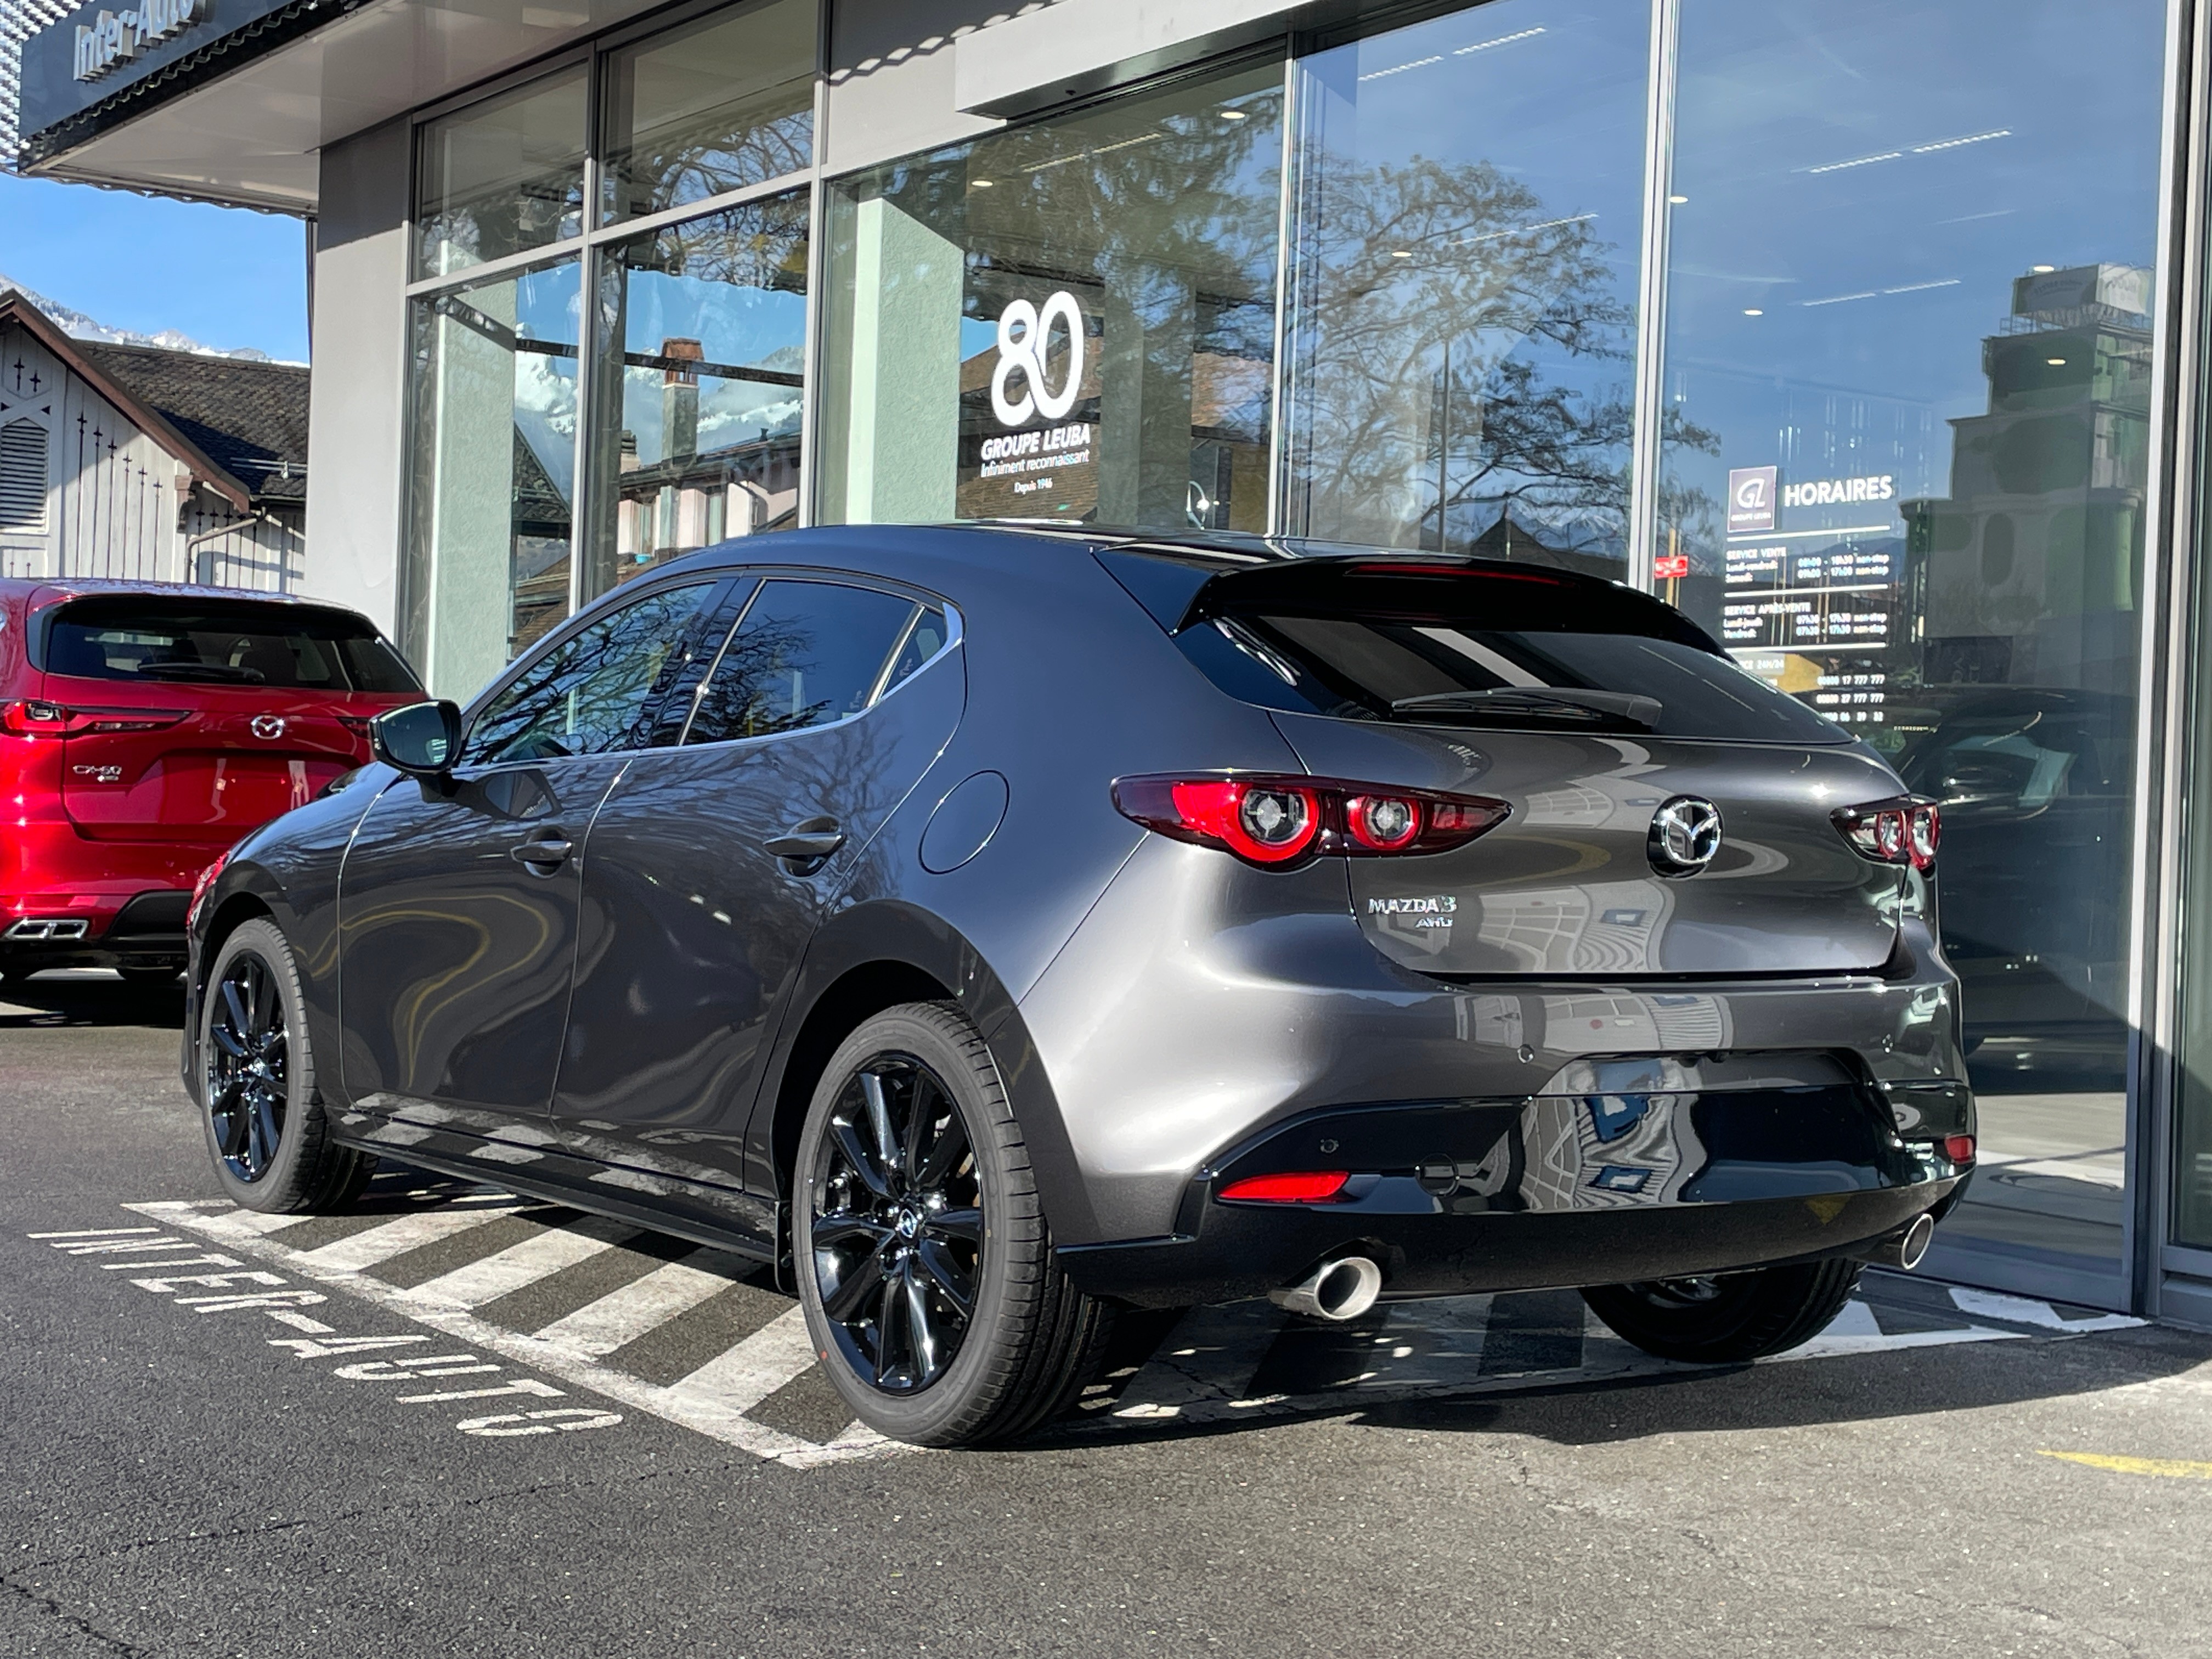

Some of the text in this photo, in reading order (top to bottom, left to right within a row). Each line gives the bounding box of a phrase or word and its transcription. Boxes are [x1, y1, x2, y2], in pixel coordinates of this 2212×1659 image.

[991, 291, 1084, 426] 80
[981, 423, 1090, 460] GROUPE LEUBA
[981, 449, 1090, 478] Infiniment reconnaissant
[1014, 480, 1036, 494] Depuis
[1785, 476, 1892, 506] HORAIRES
[1726, 547, 1786, 560] SERVICE VENTE
[1725, 605, 1756, 616] SERVICE
[1842, 675, 1852, 685] 17
[1854, 675, 1868, 685] 777
[1871, 675, 1884, 684] 777
[1854, 693, 1867, 703] 777
[1870, 693, 1884, 702] 777
[1415, 917, 1453, 928] AWD
[26, 1227, 624, 1437] INTER-AUTO
